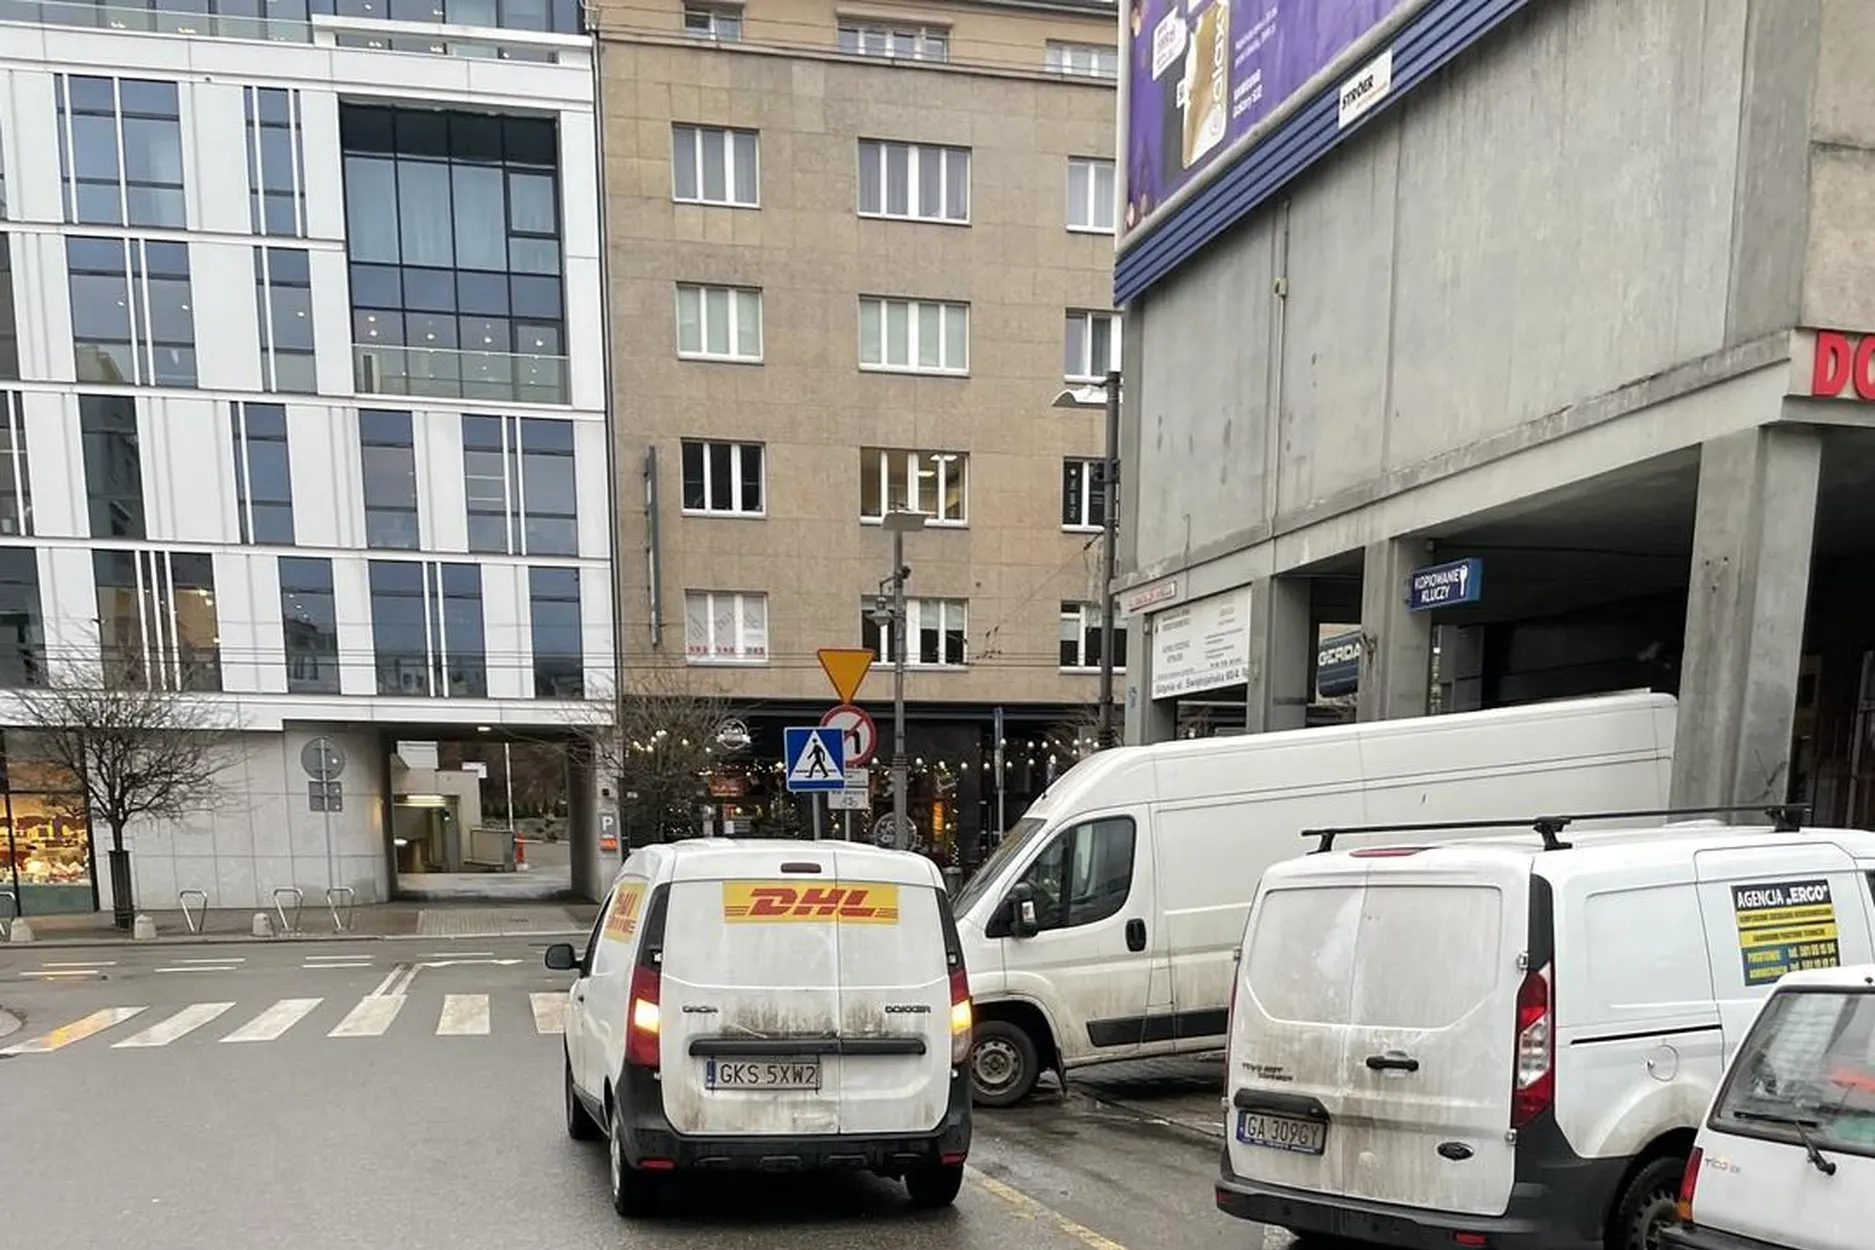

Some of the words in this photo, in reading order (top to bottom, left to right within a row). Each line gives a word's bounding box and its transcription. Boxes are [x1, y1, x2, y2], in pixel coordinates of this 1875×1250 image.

[1414, 570, 1460, 590] KOPIOWANIE
[1421, 585, 1451, 603] KLUCZY
[1318, 641, 1361, 667] GERDA
[602, 816, 613, 830] P
[749, 888, 875, 917] DHL
[1737, 889, 1784, 908] AGENCJA
[720, 1064, 760, 1084] GKS
[766, 1064, 817, 1084] 5XW2
[1247, 1116, 1265, 1138] GA
[1271, 1120, 1319, 1146] 309GY
